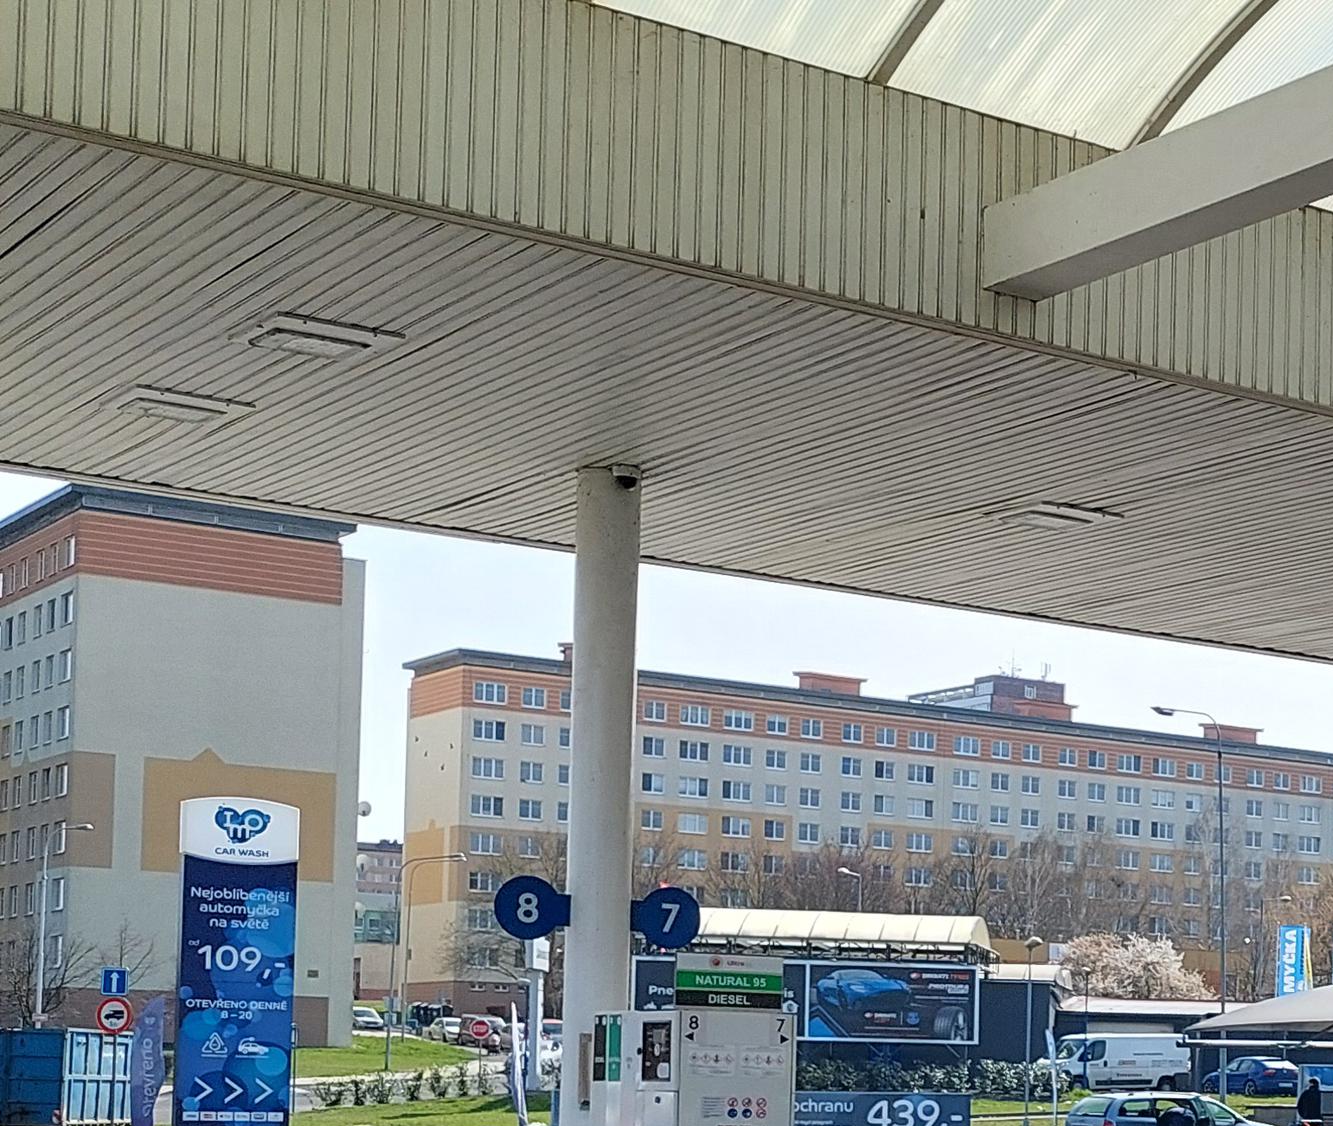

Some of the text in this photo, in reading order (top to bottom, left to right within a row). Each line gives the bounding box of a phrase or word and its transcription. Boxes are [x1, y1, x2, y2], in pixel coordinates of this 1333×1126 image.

[215, 847, 269, 858] CAR WASH
[199, 903, 280, 918] automyčka
[517, 892, 539, 924] 8
[209, 918, 269, 930] na světě
[661, 903, 680, 933] 7
[1283, 929, 1297, 993] MYČKA
[695, 975, 767, 987] NATURAL 95
[185, 997, 248, 1010] OTEVŘENO
[708, 994, 752, 1005] DIESEL
[238, 1011, 253, 1020] 20
[689, 1015, 699, 1030] 8
[776, 1018, 786, 1032] 7
